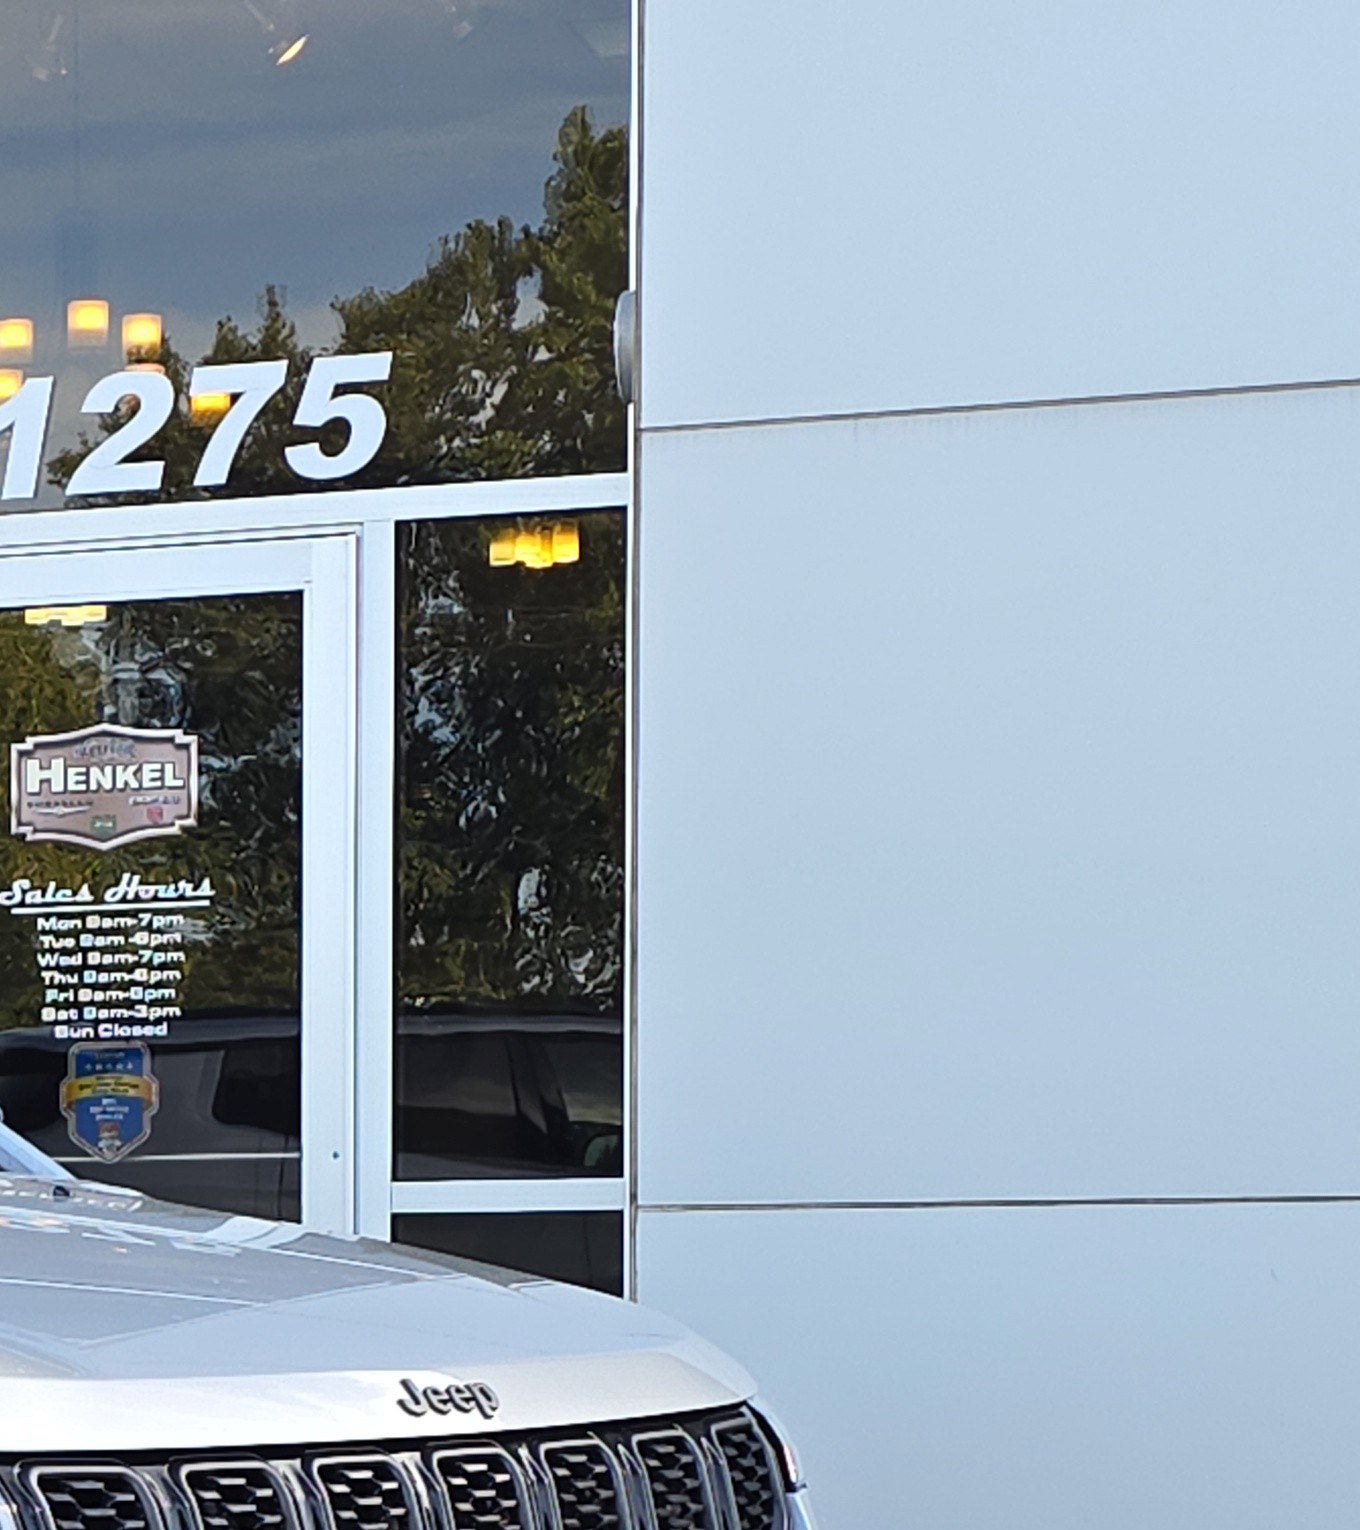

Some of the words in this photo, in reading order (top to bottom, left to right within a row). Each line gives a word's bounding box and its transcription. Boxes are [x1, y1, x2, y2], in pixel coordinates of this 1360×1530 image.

[26, 757, 185, 795] HENKEL
[104, 873, 216, 903] Hours
[37, 916, 82, 931] Mon
[39, 935, 76, 949] Tue
[37, 952, 82, 967] Wed
[41, 970, 78, 985] Thu
[45, 988, 74, 1003] Fri
[41, 1006, 78, 1022] Sat
[54, 1024, 94, 1039] Sun
[97, 1021, 168, 1038] Closed
[397, 1378, 500, 1420] Jeep
